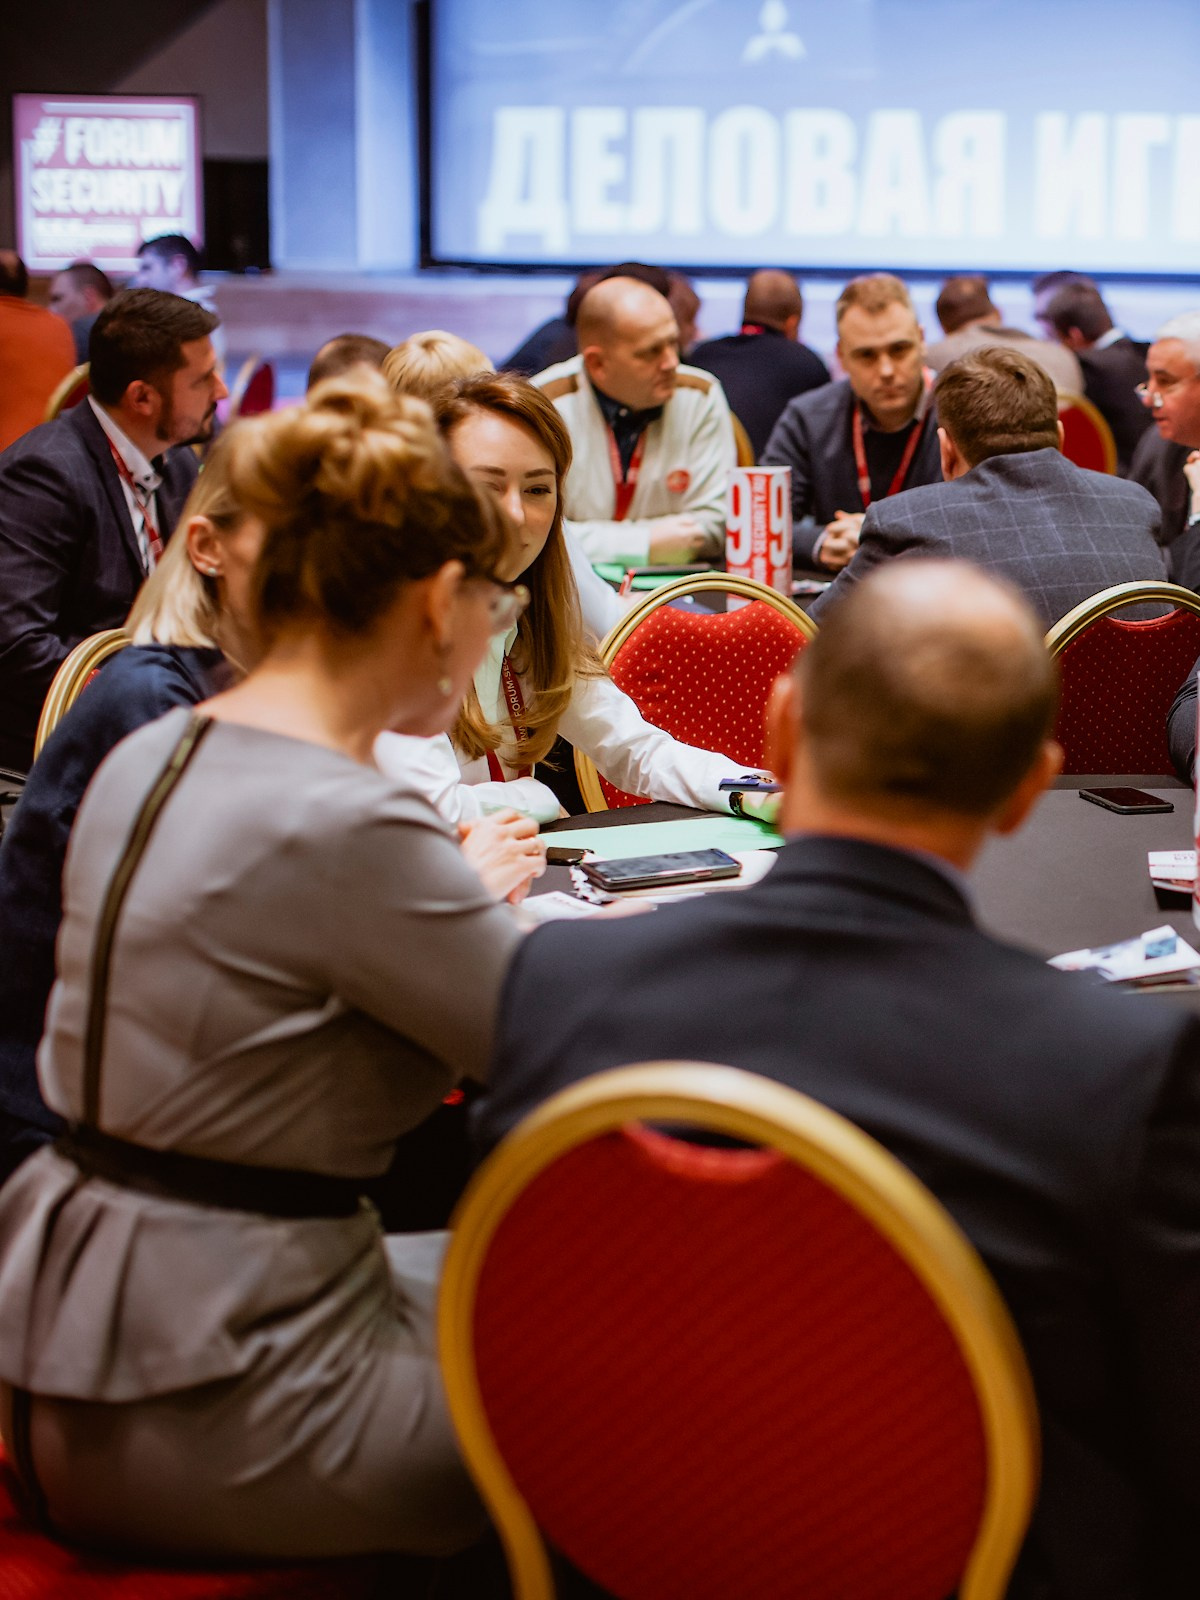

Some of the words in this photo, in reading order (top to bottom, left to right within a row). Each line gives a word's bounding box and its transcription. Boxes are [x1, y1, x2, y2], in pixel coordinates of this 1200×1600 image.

[32, 169, 185, 216] SECURITY
[478, 105, 1006, 252] ДЕЛОВАЯ
[726, 473, 751, 565] 9
[769, 474, 788, 568] 9
